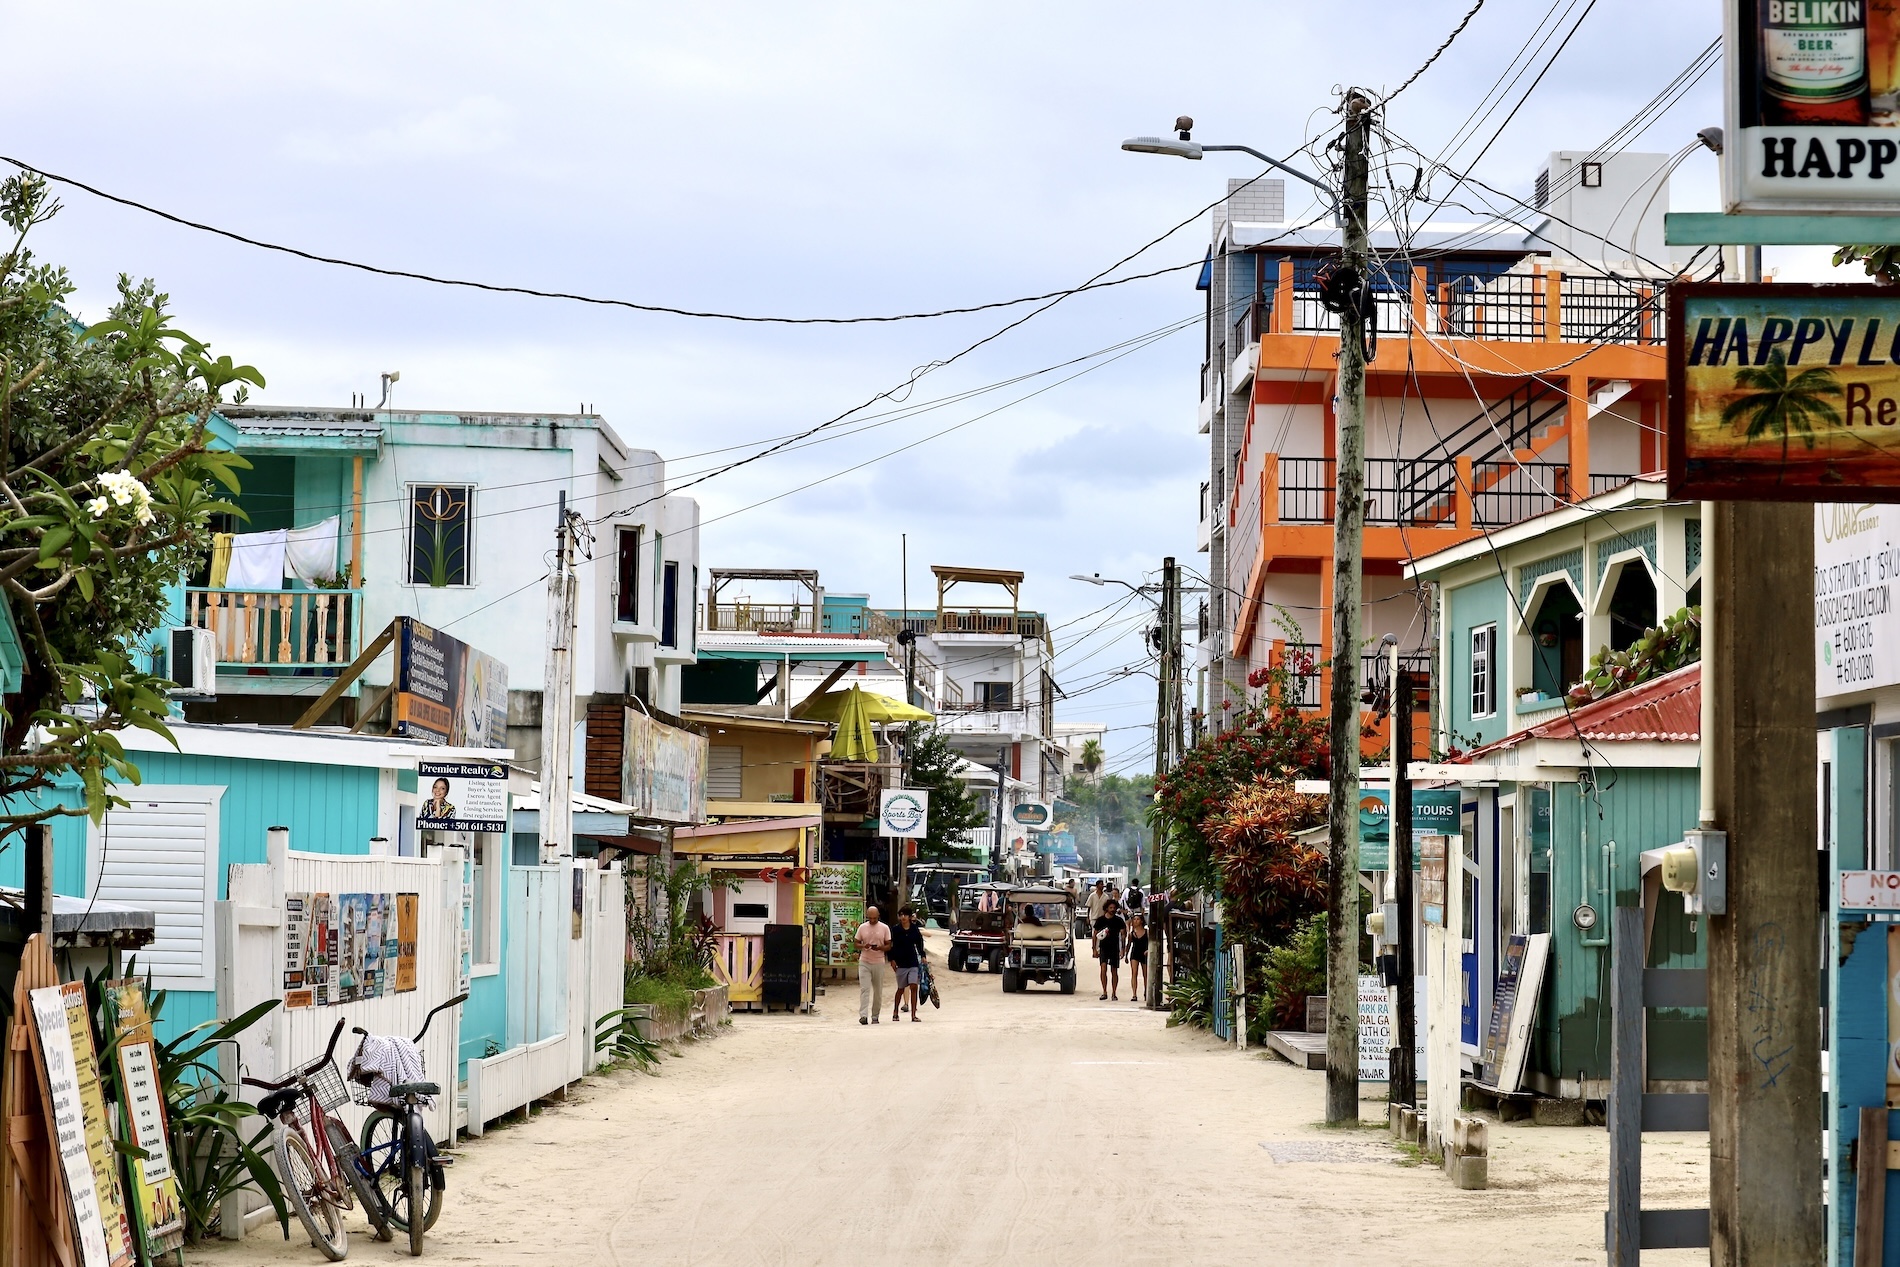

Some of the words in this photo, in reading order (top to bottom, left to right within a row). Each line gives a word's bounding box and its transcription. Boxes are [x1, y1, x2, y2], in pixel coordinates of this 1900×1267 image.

[1769, 0, 1860, 24] BELIKIN
[1798, 39, 1833, 50] BEER
[1761, 137, 1900, 179] HAPP
[1846, 382, 1897, 426] Re
[1828, 560, 1860, 594] STARTING
[1862, 556, 1871, 586] AT
[421, 764, 459, 774] Premier
[460, 765, 490, 777] Realty
[882, 809, 906, 819] Sports
[907, 810, 923, 819] Bar
[1416, 805, 1454, 815] TOURS
[417, 820, 448, 829] Phone:
[449, 822, 470, 831] +501
[470, 822, 504, 831] 611-5131
[812, 866, 860, 880] AMBOOZE
[1871, 873, 1900, 890] NO
[118, 1007, 130, 1018] Juice
[1377, 1004, 1389, 1014] RA
[38, 1003, 65, 1037] Special
[134, 1050, 142, 1058] Coffee
[50, 1047, 65, 1076] Day
[1358, 1068, 1385, 1079] ANWAR
